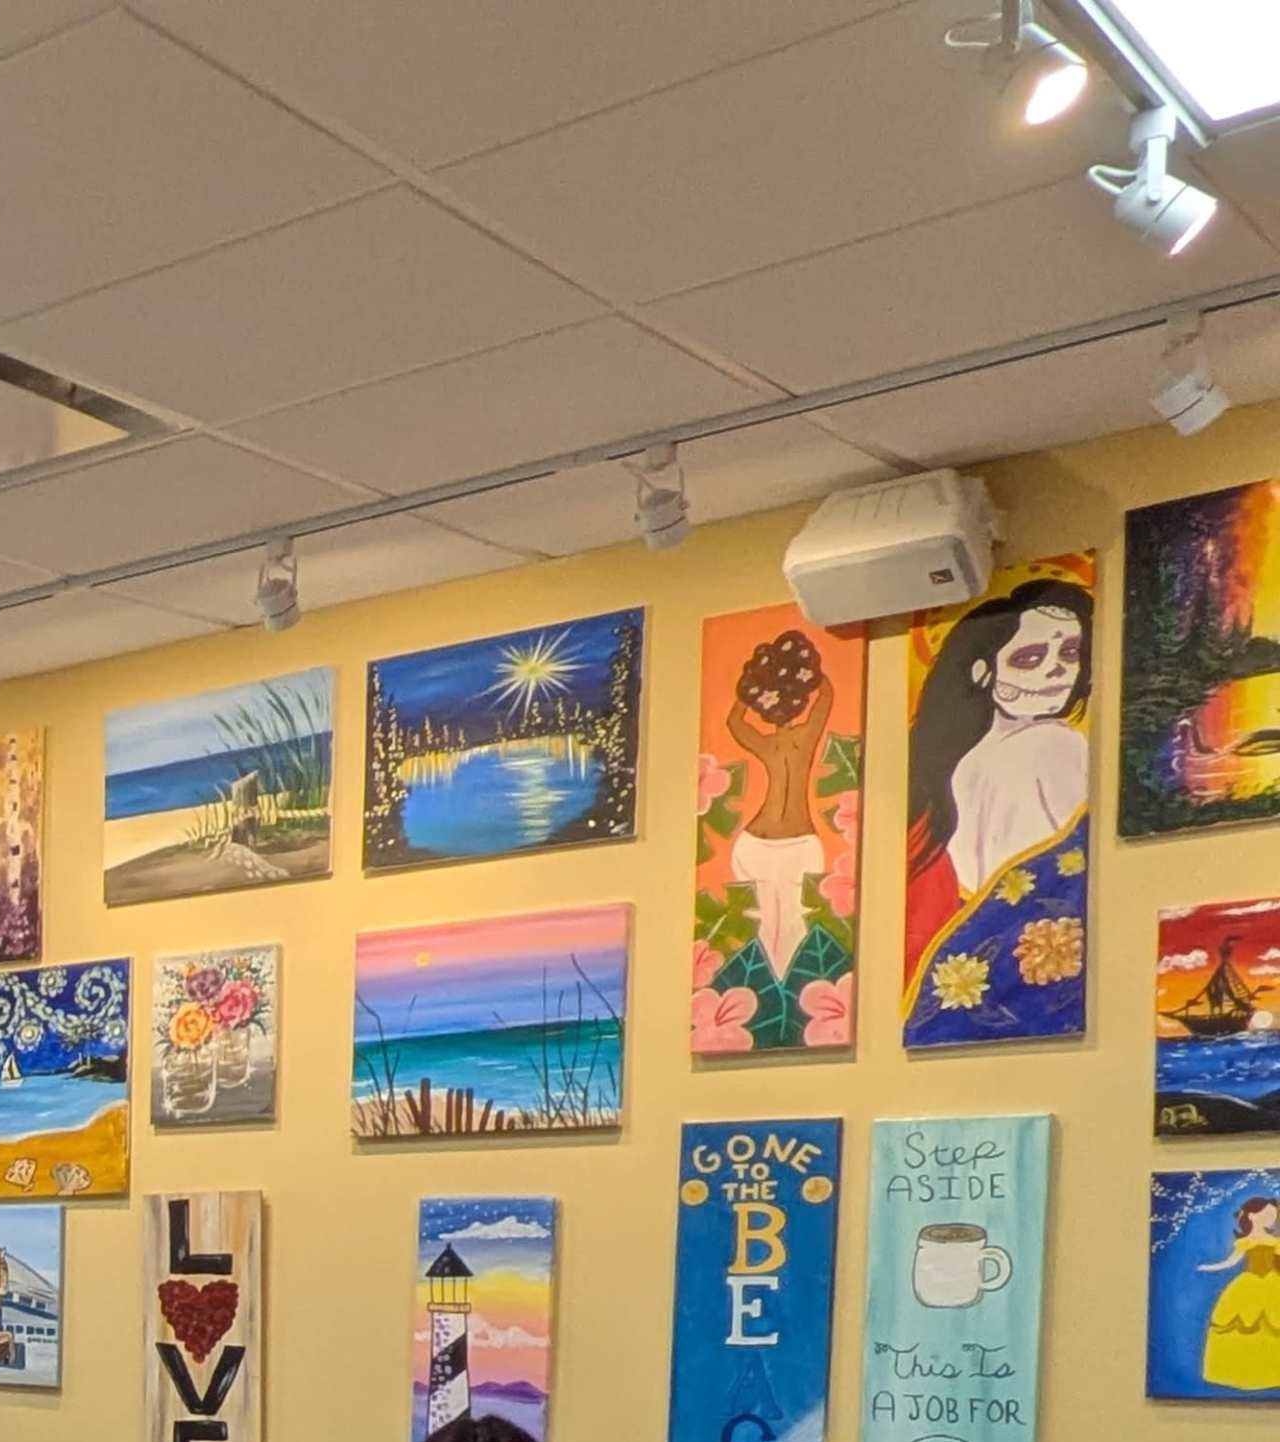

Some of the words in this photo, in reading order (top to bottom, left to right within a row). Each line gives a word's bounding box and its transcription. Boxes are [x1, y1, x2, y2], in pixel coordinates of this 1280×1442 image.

[692, 1132, 822, 1174] GONE
[903, 1130, 1006, 1169] Step
[732, 1162, 770, 1181] TO
[886, 1173, 1006, 1203] ASIDE
[721, 1180, 778, 1202] THE
[871, 1389, 896, 1422] A
[903, 1393, 960, 1424] JOB
[969, 1398, 1028, 1426] FOR
